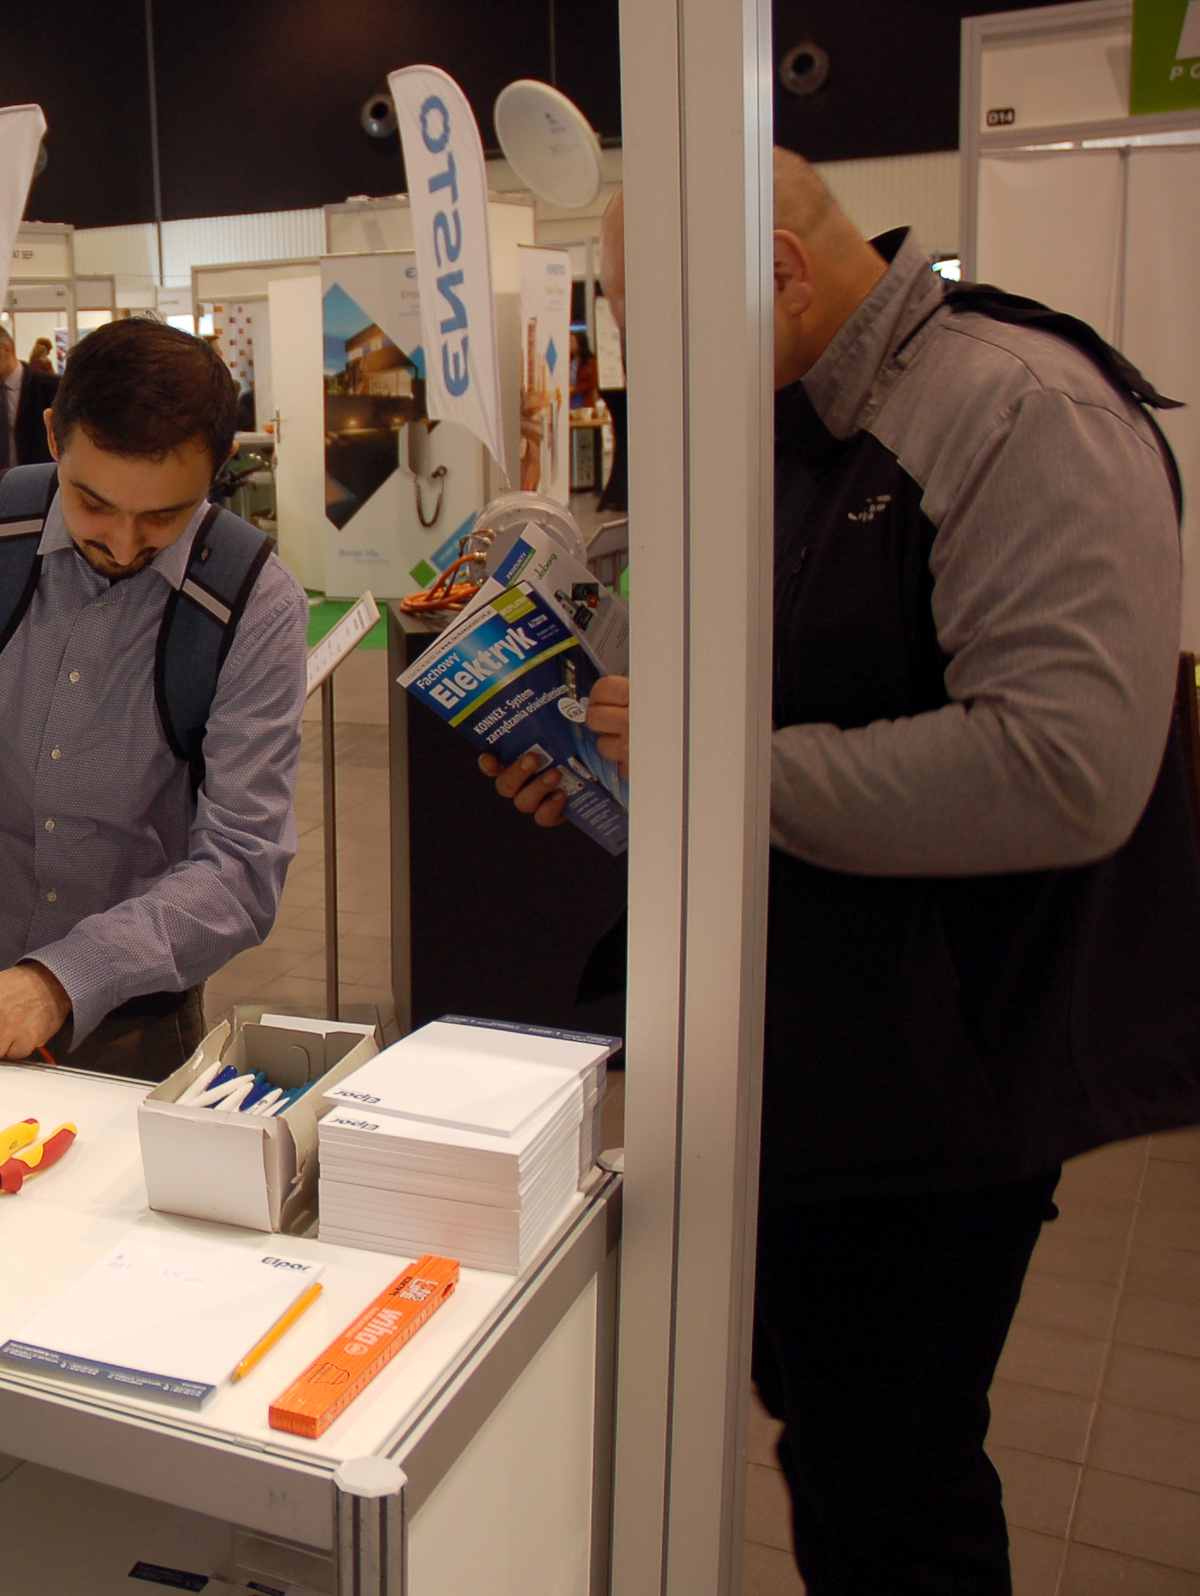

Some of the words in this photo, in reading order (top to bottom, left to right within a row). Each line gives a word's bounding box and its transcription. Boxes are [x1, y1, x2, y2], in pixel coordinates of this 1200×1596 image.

[988, 110, 1014, 125] D14
[505, 551, 527, 580] PRODUKTY
[416, 652, 461, 690] Fachowy
[429, 627, 538, 709] Elektryk
[473, 707, 507, 735] KONNEX
[506, 688, 535, 709] System
[486, 709, 529, 744] zarządzania
[526, 684, 569, 714] oświetleniem
[261, 1256, 313, 1272] Elpar
[356, 1307, 402, 1346] wiha
